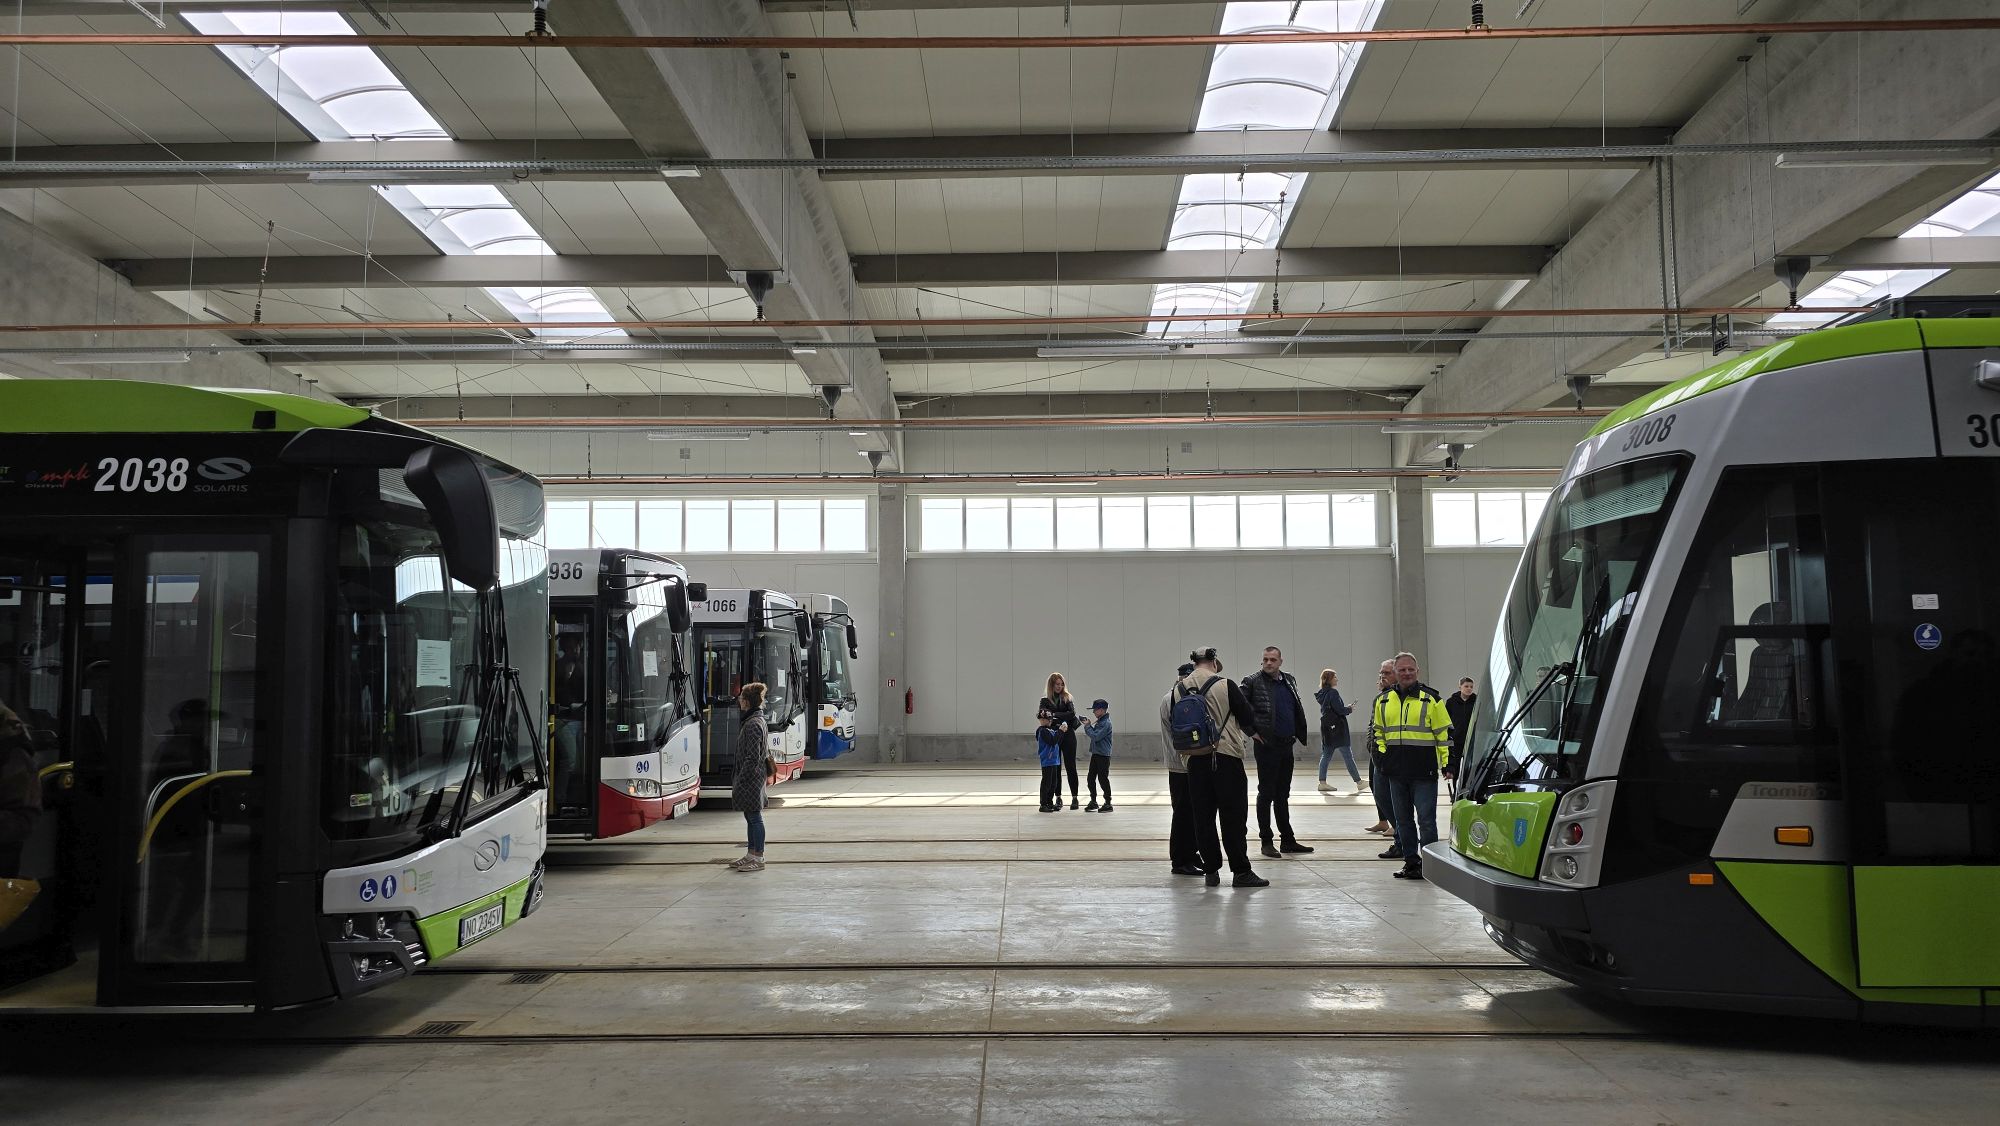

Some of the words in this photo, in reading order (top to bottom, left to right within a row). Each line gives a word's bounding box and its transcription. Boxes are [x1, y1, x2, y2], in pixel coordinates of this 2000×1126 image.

[1622, 413, 1677, 452] 3008
[94, 457, 189, 492] 2038
[193, 484, 249, 493] SOLARIS
[549, 562, 583, 580] 936
[705, 599, 737, 612] 1066
[1749, 784, 1828, 797] Tramino
[465, 918, 477, 938] NO
